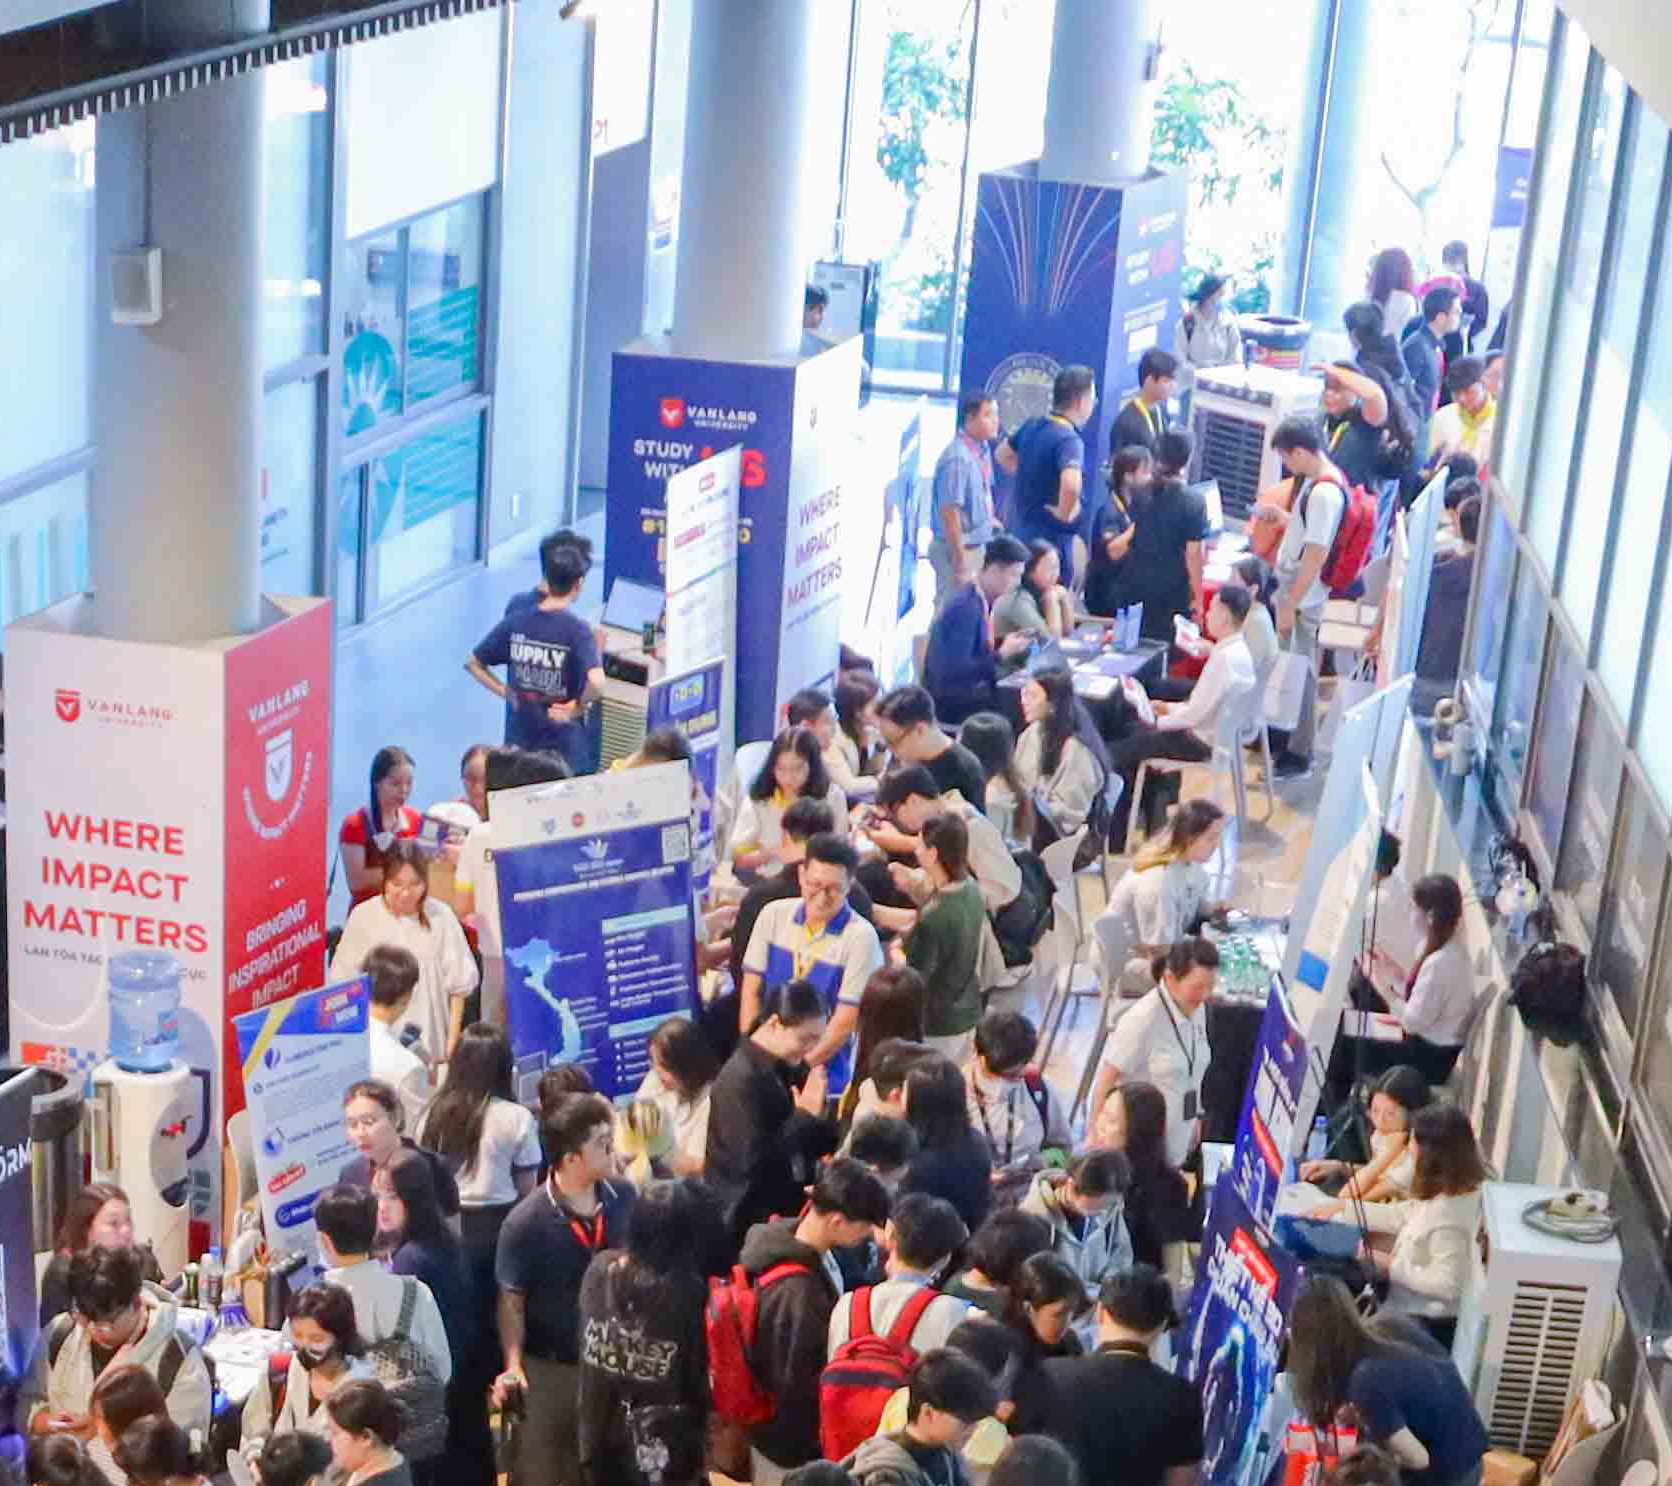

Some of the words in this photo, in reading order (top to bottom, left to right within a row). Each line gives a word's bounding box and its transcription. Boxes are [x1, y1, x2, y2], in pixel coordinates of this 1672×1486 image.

[634, 438, 693, 459] STUDY
[800, 485, 841, 528] WHERE
[787, 556, 842, 608] MATTERS
[87, 698, 173, 721] VANLANG
[43, 809, 185, 856] WHERE
[41, 857, 189, 903] IMPACT
[23, 900, 209, 954] MATTERS
[245, 899, 307, 952] BRINGING
[227, 920, 323, 993] INSPIRATIONAL
